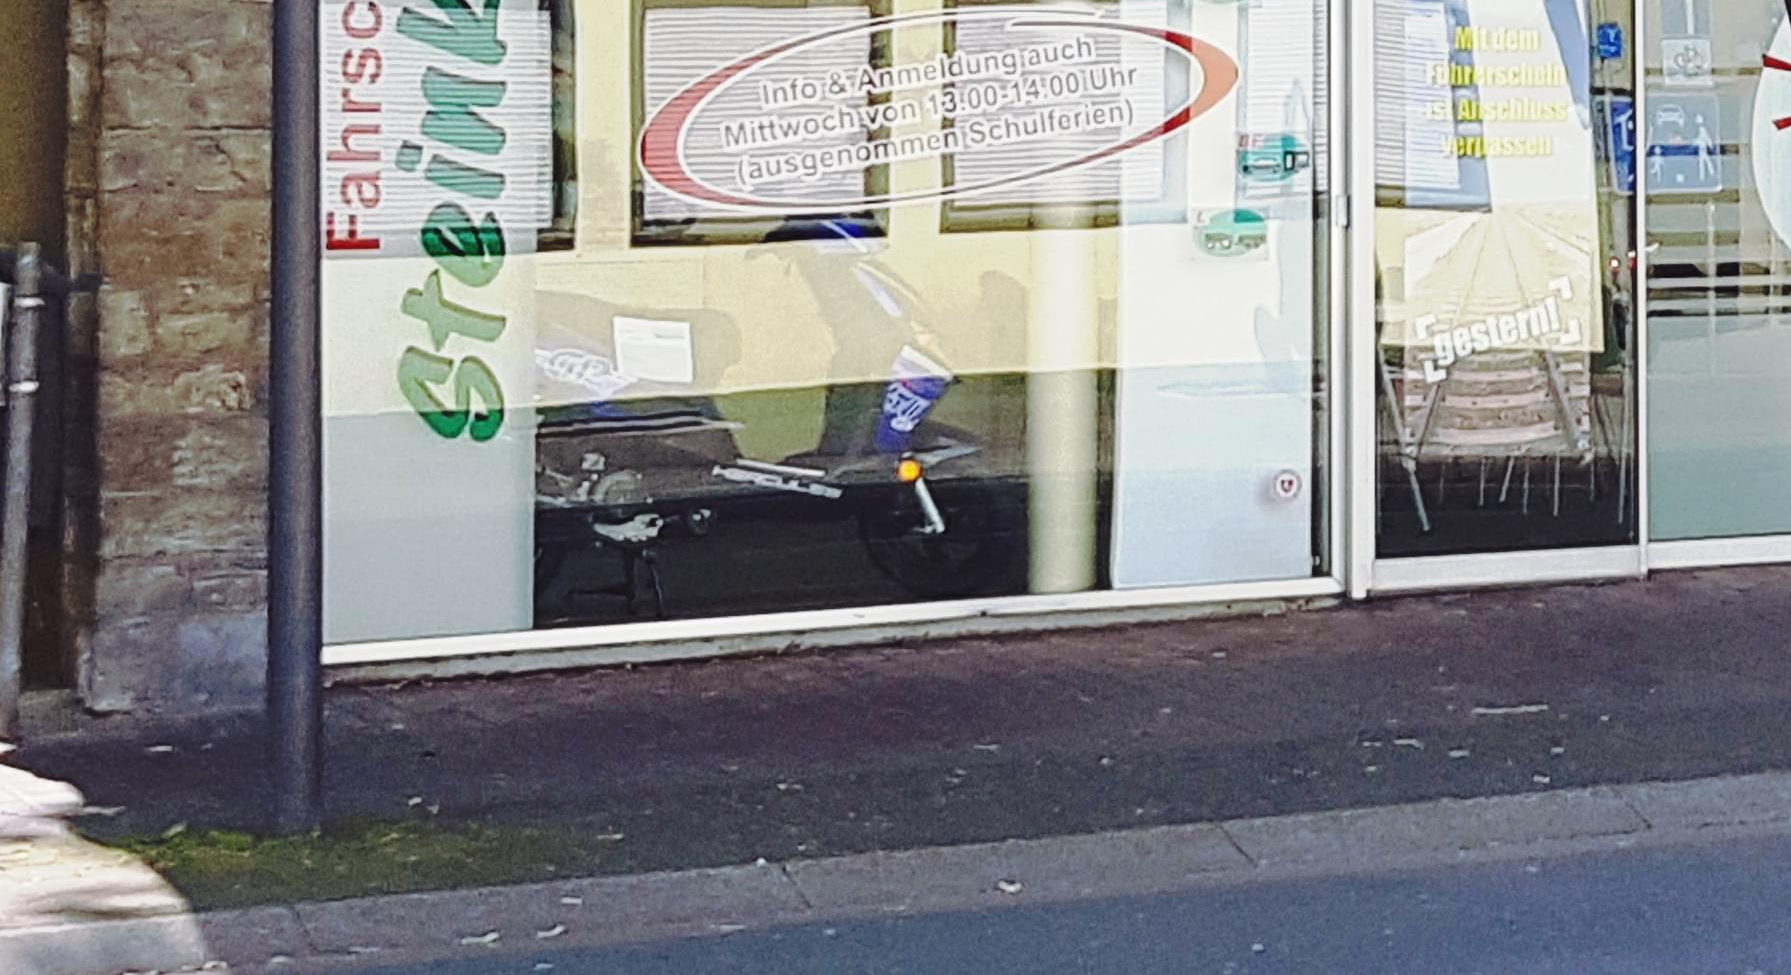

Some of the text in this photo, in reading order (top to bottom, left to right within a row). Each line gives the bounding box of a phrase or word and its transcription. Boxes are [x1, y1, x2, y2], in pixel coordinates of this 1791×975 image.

[762, 37, 1093, 105] Info & Anmeldung auch
[1491, 26, 1540, 51] dem
[723, 66, 1137, 147] Mittwoch von 13.00-14.00 Uhr
[737, 99, 1134, 184] (ausgenommen Schulferien)
[1434, 297, 1562, 365] gestern!
